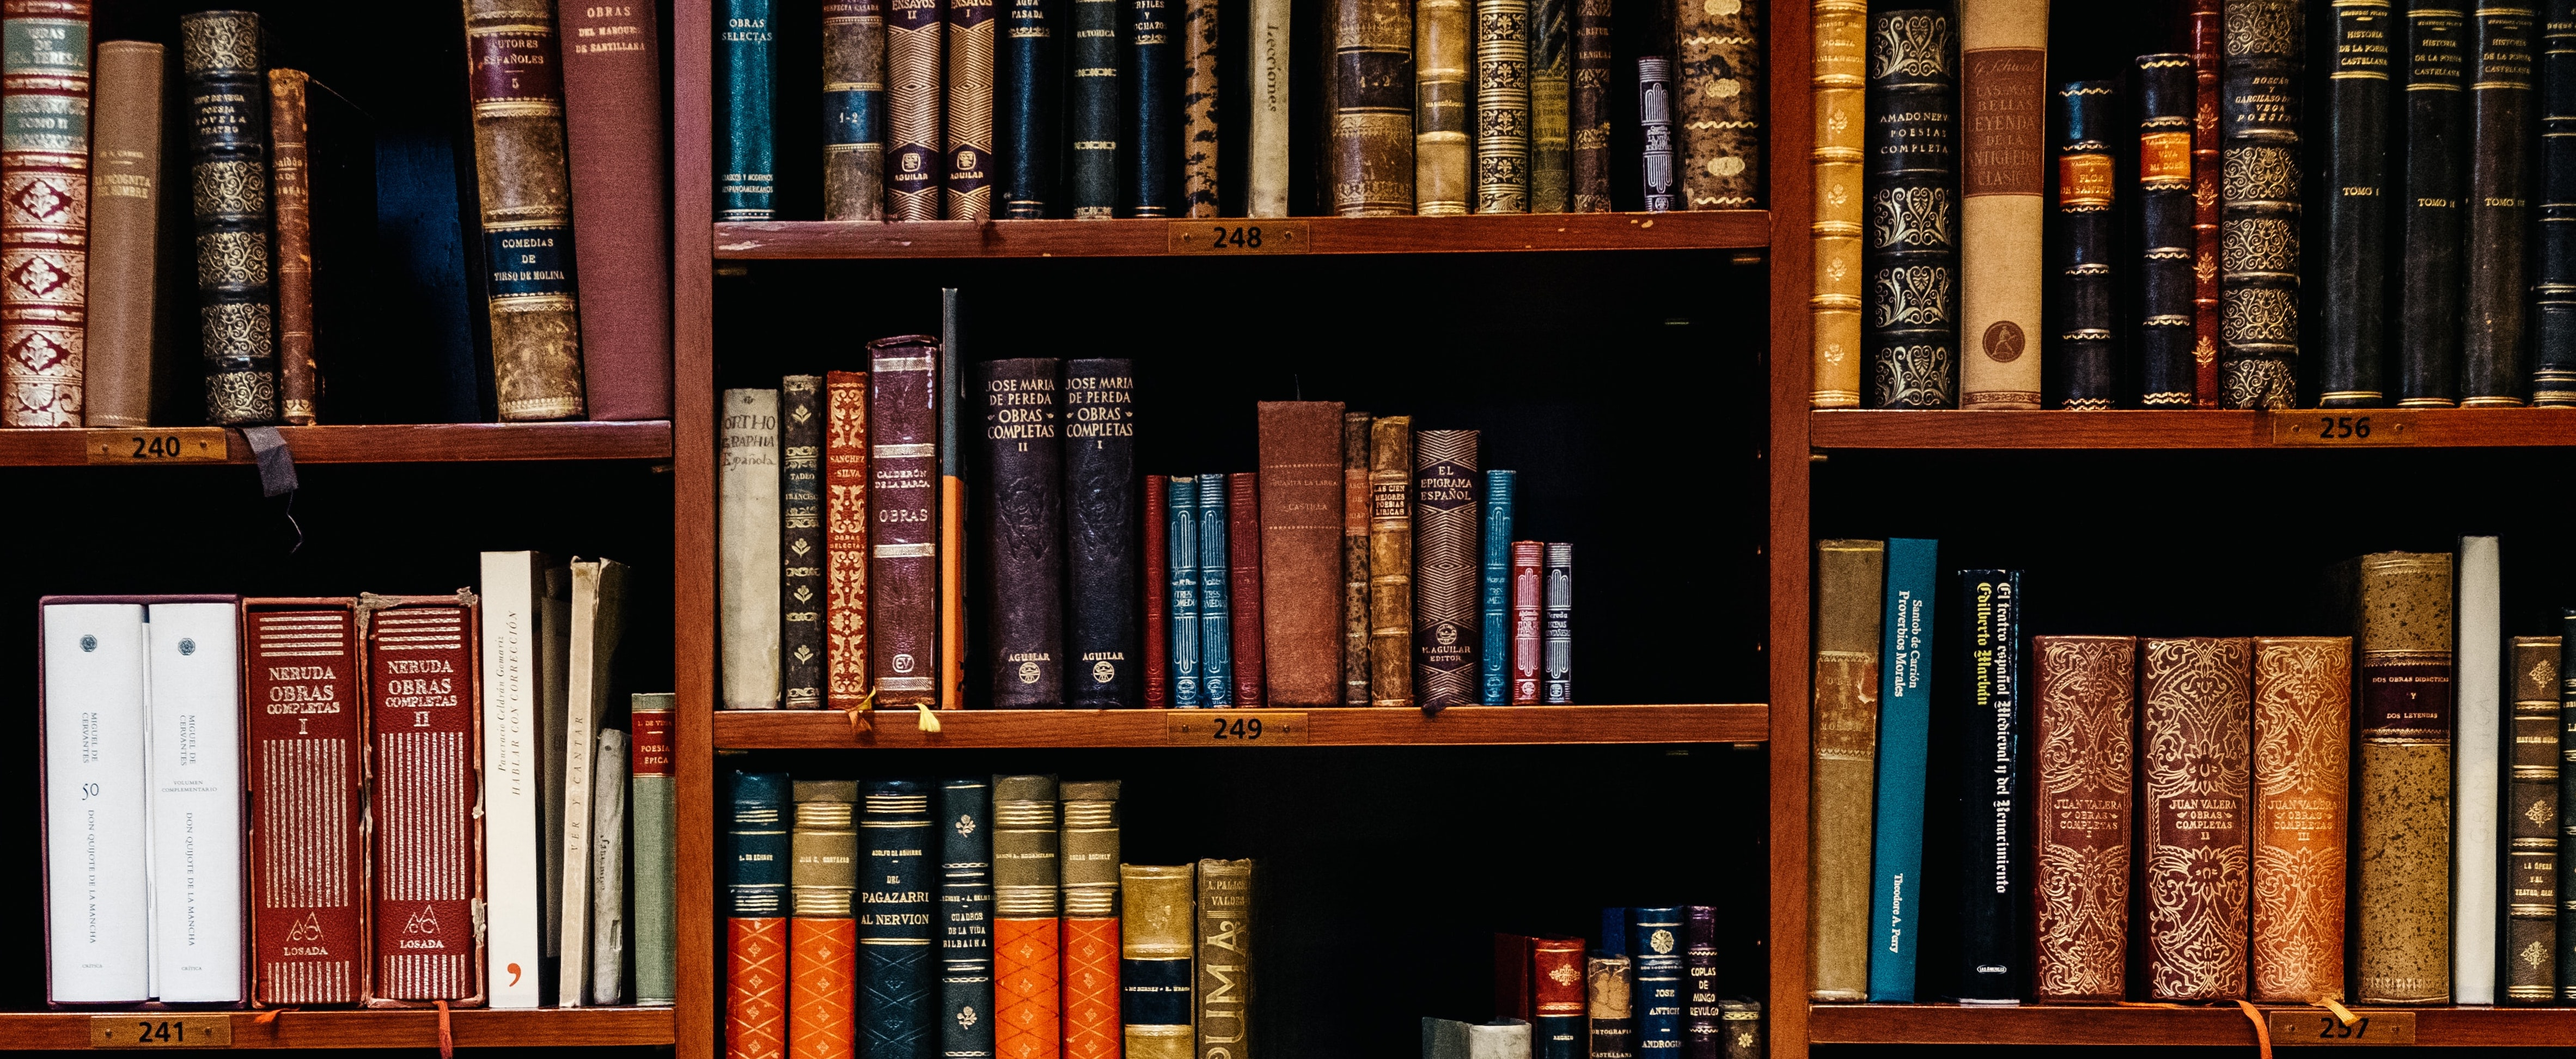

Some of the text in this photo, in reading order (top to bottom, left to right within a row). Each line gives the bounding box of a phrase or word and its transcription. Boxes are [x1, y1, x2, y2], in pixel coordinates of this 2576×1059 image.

[587, 7, 631, 17] OBRAS
[907, 10, 917, 20] II
[1011, 10, 1043, 19] PASADA
[729, 19, 765, 28] OBRAS
[722, 33, 772, 41] SELECTAS
[484, 54, 544, 65] ESPAÑOLES
[2341, 58, 2388, 66] CASTELLANA
[2414, 68, 2460, 77] CASTELLANA
[2235, 95, 2280, 103] GARCILASO
[1979, 100, 2033, 110] BELLAS
[1881, 113, 1921, 123] AMADO
[894, 173, 929, 181] AGUILAR
[950, 171, 984, 179] AGUILAR
[2343, 187, 2372, 196] TOMO
[2418, 199, 2447, 207] TOMO
[2485, 199, 2514, 207] TOMO
[1213, 227, 1262, 248] 248
[502, 238, 553, 248] COMEDIAS
[522, 254, 535, 264] DE
[495, 271, 564, 281] TIRSO MOLINA
[986, 379, 1055, 391] JOSE MARIA
[1065, 377, 1133, 390] JOSE MARIA
[990, 393, 1052, 406] DE PEREDA
[1069, 391, 1131, 404] DE PEREDA
[999, 409, 1042, 423] OBRAS
[1077, 407, 1121, 421] OBRAS
[725, 414, 776, 430] ORTHO
[988, 424, 1054, 439] COMPLETAS
[1066, 423, 1133, 438] COMPLETAS
[2319, 417, 2370, 438] 256
[132, 437, 180, 457] 240
[1018, 442, 1028, 452] II
[1097, 440, 1103, 449] I
[830, 455, 864, 463] SANCHEZ
[877, 469, 927, 479] CALDERÓN
[1438, 466, 1454, 475] EL
[901, 480, 930, 488] BARCA
[1421, 479, 1472, 487] EPIGRAMA
[1421, 488, 1471, 500] ESPAÑOL
[879, 509, 927, 523] OBRAS
[1997, 583, 2011, 599] El
[1997, 603, 2010, 641] teatro
[1894, 591, 1910, 697] Proverbios Morales
[1909, 599, 1922, 688] Santob de Carrión
[1009, 653, 1050, 662] AGUILAR
[1082, 652, 1124, 661] AGUILAR
[387, 660, 454, 674] NERUDA
[1994, 645, 2010, 695] español
[269, 666, 336, 681] NERUDA
[388, 678, 451, 695] OBRAS
[270, 684, 334, 701] OBRAS
[385, 695, 457, 708] COMPLETAS
[495, 636, 506, 771] Pancracio Celdrán Gomariz
[506, 610, 520, 795] HABLAR CON CORRECCIÓN
[267, 702, 340, 714] COMPLETAS
[413, 711, 430, 727] II
[298, 718, 308, 734] I
[1213, 719, 1262, 740] 249
[1994, 701, 2011, 762] Medieval
[571, 717, 583, 851] VER CANTAR
[1997, 777, 2010, 795] del
[2054, 799, 2122, 810] JUAN VALERA
[2169, 799, 2237, 810] JUAN VALERA
[2268, 799, 2337, 810] JUAN VALERA
[2075, 811, 2108, 819] OBRAS
[2190, 811, 2224, 819] OBRAS
[2288, 811, 2322, 819] OBRAS
[2060, 821, 2117, 830] COMPLETAS
[2176, 821, 2232, 829] COMPLETAS
[2274, 821, 2333, 830] COMPLETAS
[1993, 799, 2010, 893] Renacimiento
[887, 876, 900, 884] DEL
[862, 892, 929, 903] PAGAZARRI
[951, 913, 983, 921] CUADROS
[1889, 873, 1903, 953] Theodore Perry
[861, 914, 929, 925] AL NERVION
[958, 927, 967, 935] LA
[969, 926, 986, 934] VIDA
[400, 940, 444, 949] LOSADA
[943, 939, 986, 948] BILBAINA
[284, 947, 328, 957] LOSADA
[1691, 967, 1716, 976] COPLAS
[1699, 981, 1708, 989] DE
[1656, 989, 1675, 997] JOSE
[1693, 993, 1715, 1002] MINGO
[1690, 1007, 1718, 1015] REVULGO
[138, 1022, 183, 1041] 241
[2319, 1017, 2369, 1038] 257
